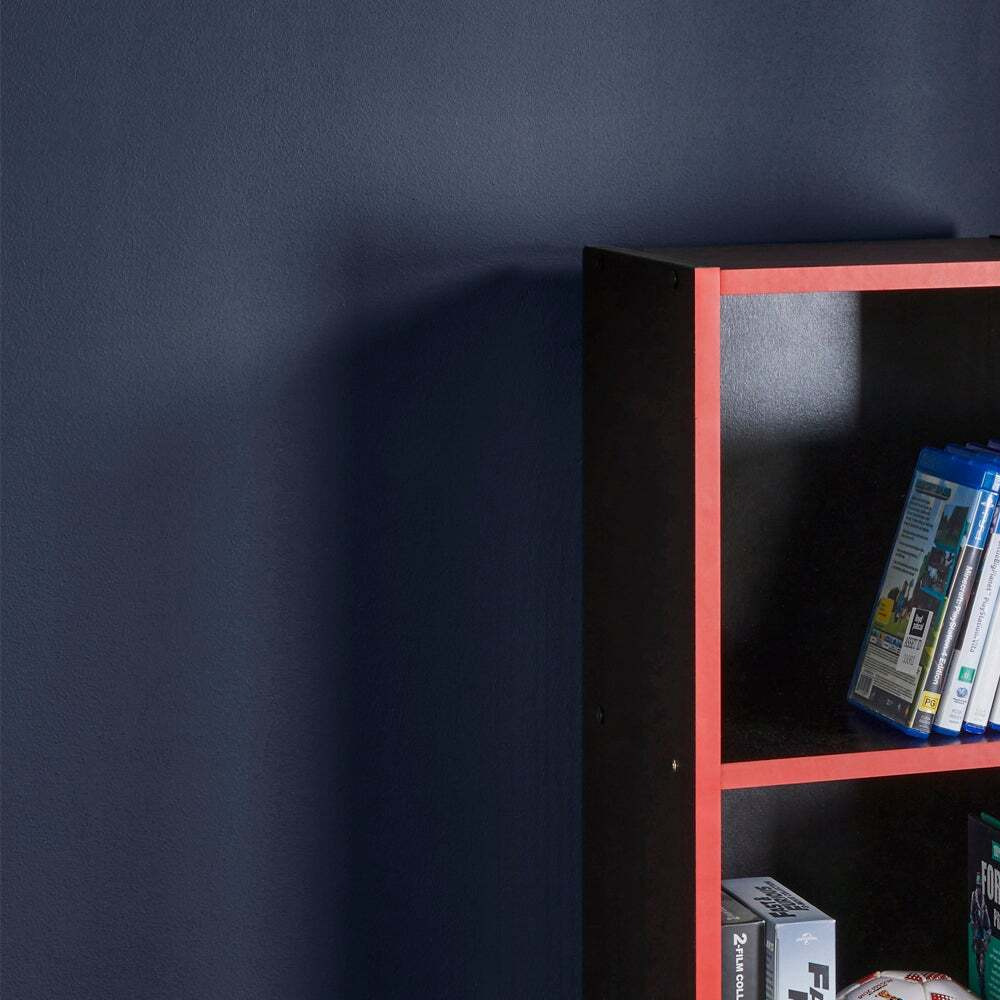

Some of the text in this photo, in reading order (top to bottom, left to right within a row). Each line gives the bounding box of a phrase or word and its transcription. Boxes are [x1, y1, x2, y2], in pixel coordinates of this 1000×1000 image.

[932, 657, 946, 686] Edition
[924, 696, 936, 708] PG
[733, 932, 747, 972] 2-FILM
